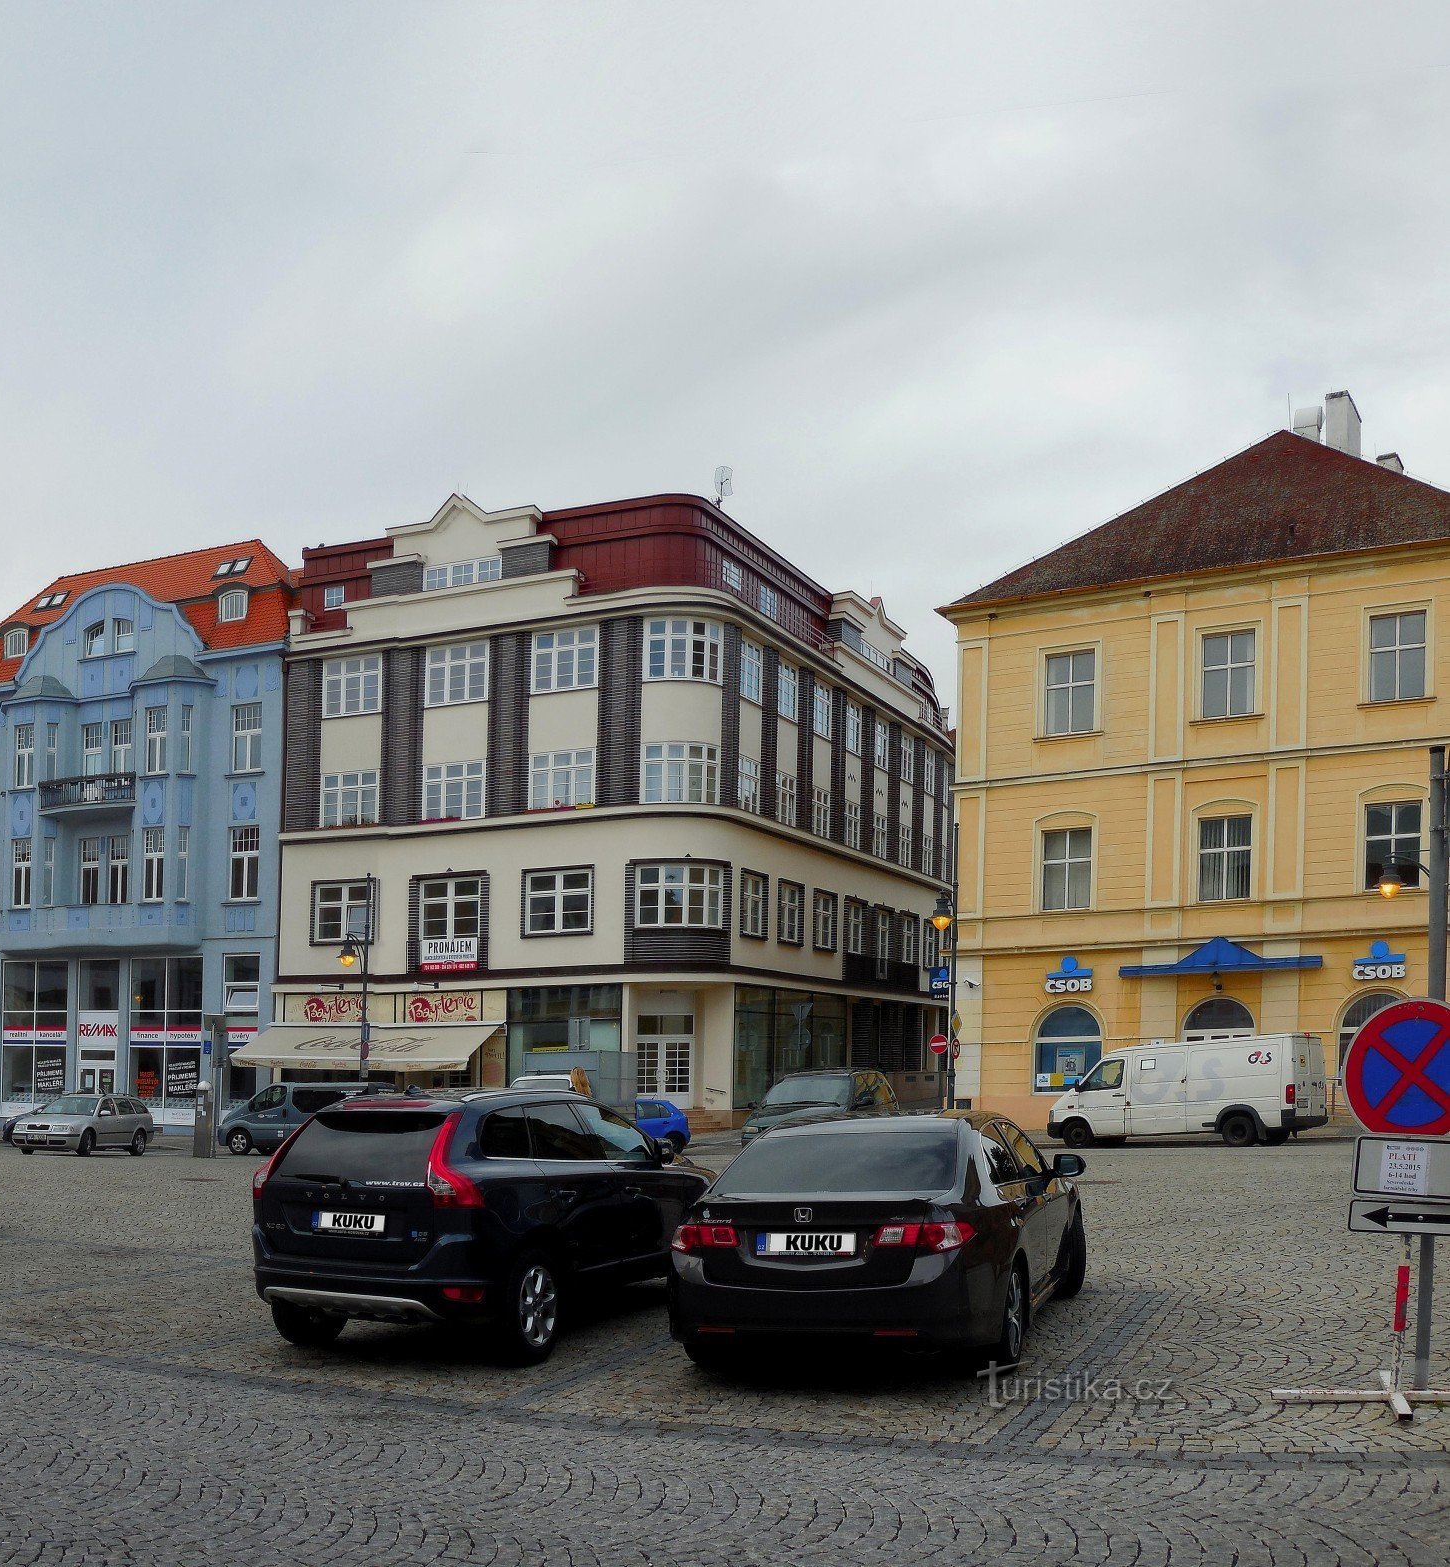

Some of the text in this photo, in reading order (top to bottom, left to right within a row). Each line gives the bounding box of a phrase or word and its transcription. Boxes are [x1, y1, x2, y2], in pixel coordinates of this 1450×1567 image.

[428, 939, 472, 954] PRONÁJEM
[1351, 964, 1406, 981] ČSOB
[932, 979, 950, 989] ČSO
[1044, 978, 1093, 994] ČSOB
[79, 1023, 118, 1037] RE/MAX
[136, 1031, 250, 1041] finance hypotéky úvěry
[1388, 1152, 1417, 1161] PLATÍ
[1388, 1162, 1421, 1171] 23.5.2015
[306, 1191, 385, 1201] VOLVO
[332, 1214, 376, 1230] KUKU
[785, 1234, 843, 1252] KUKU
